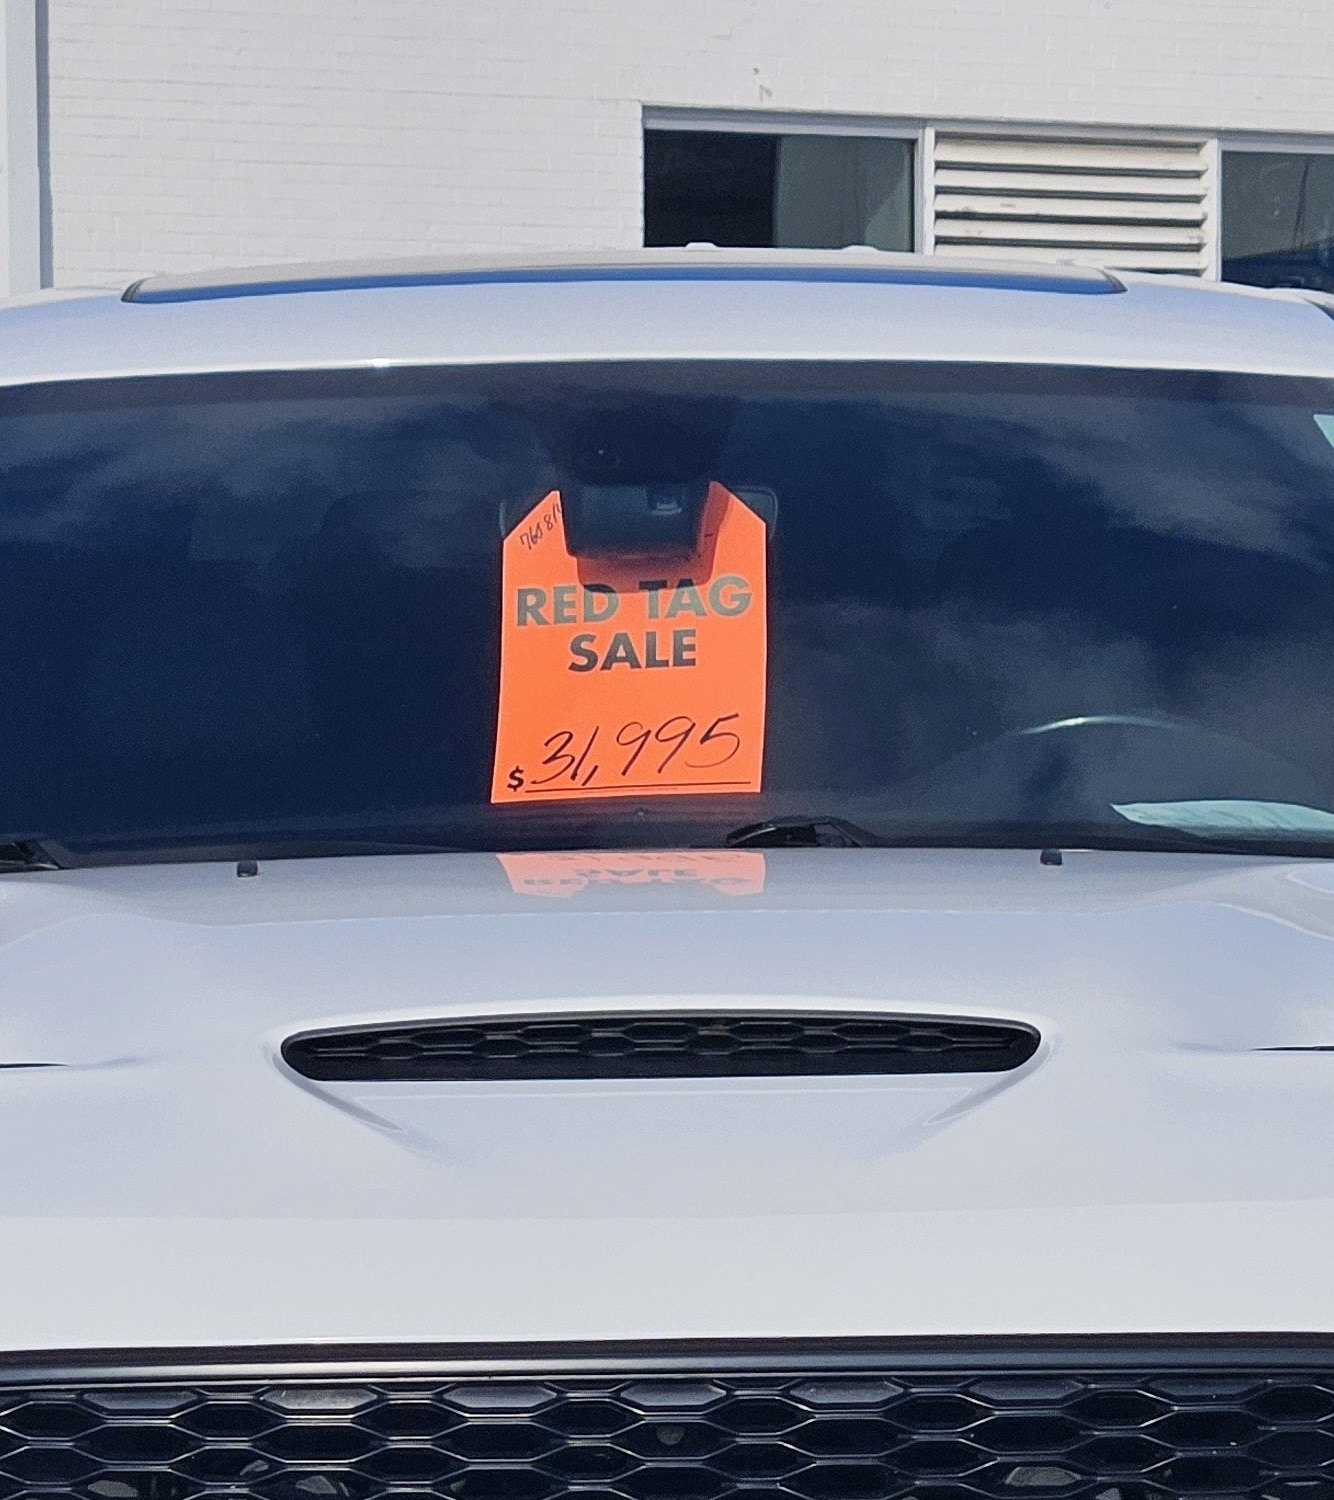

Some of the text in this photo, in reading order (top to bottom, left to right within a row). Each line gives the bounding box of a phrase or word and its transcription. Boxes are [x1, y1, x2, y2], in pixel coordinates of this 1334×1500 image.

[516, 573, 753, 627] RED TAG
[568, 628, 697, 673] SALE
